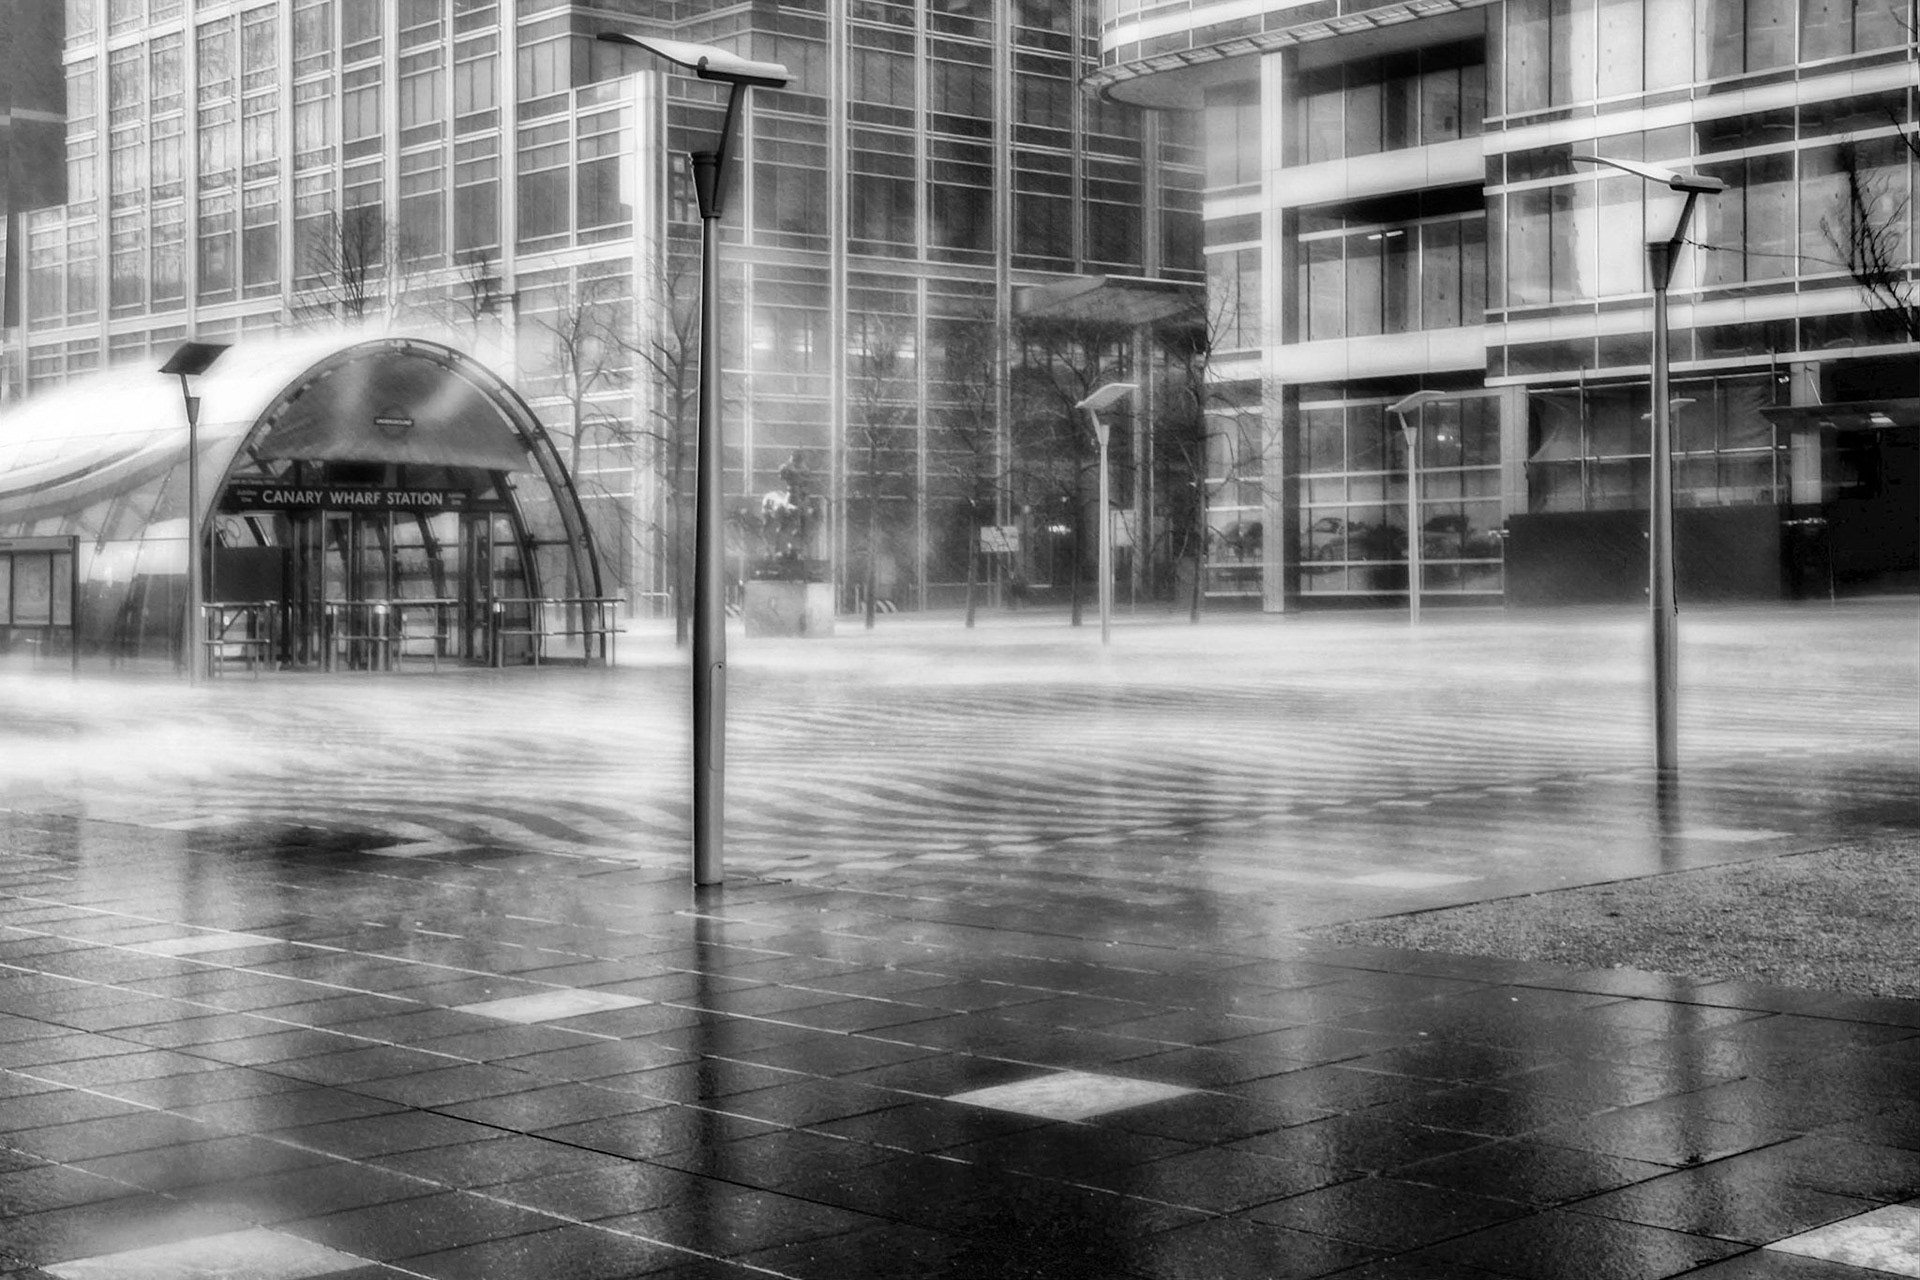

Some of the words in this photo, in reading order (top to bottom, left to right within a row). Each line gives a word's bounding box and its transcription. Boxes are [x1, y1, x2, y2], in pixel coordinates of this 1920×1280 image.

[262, 489, 323, 504] CANARY
[329, 491, 382, 505] WHARF
[386, 491, 443, 506] STATION
